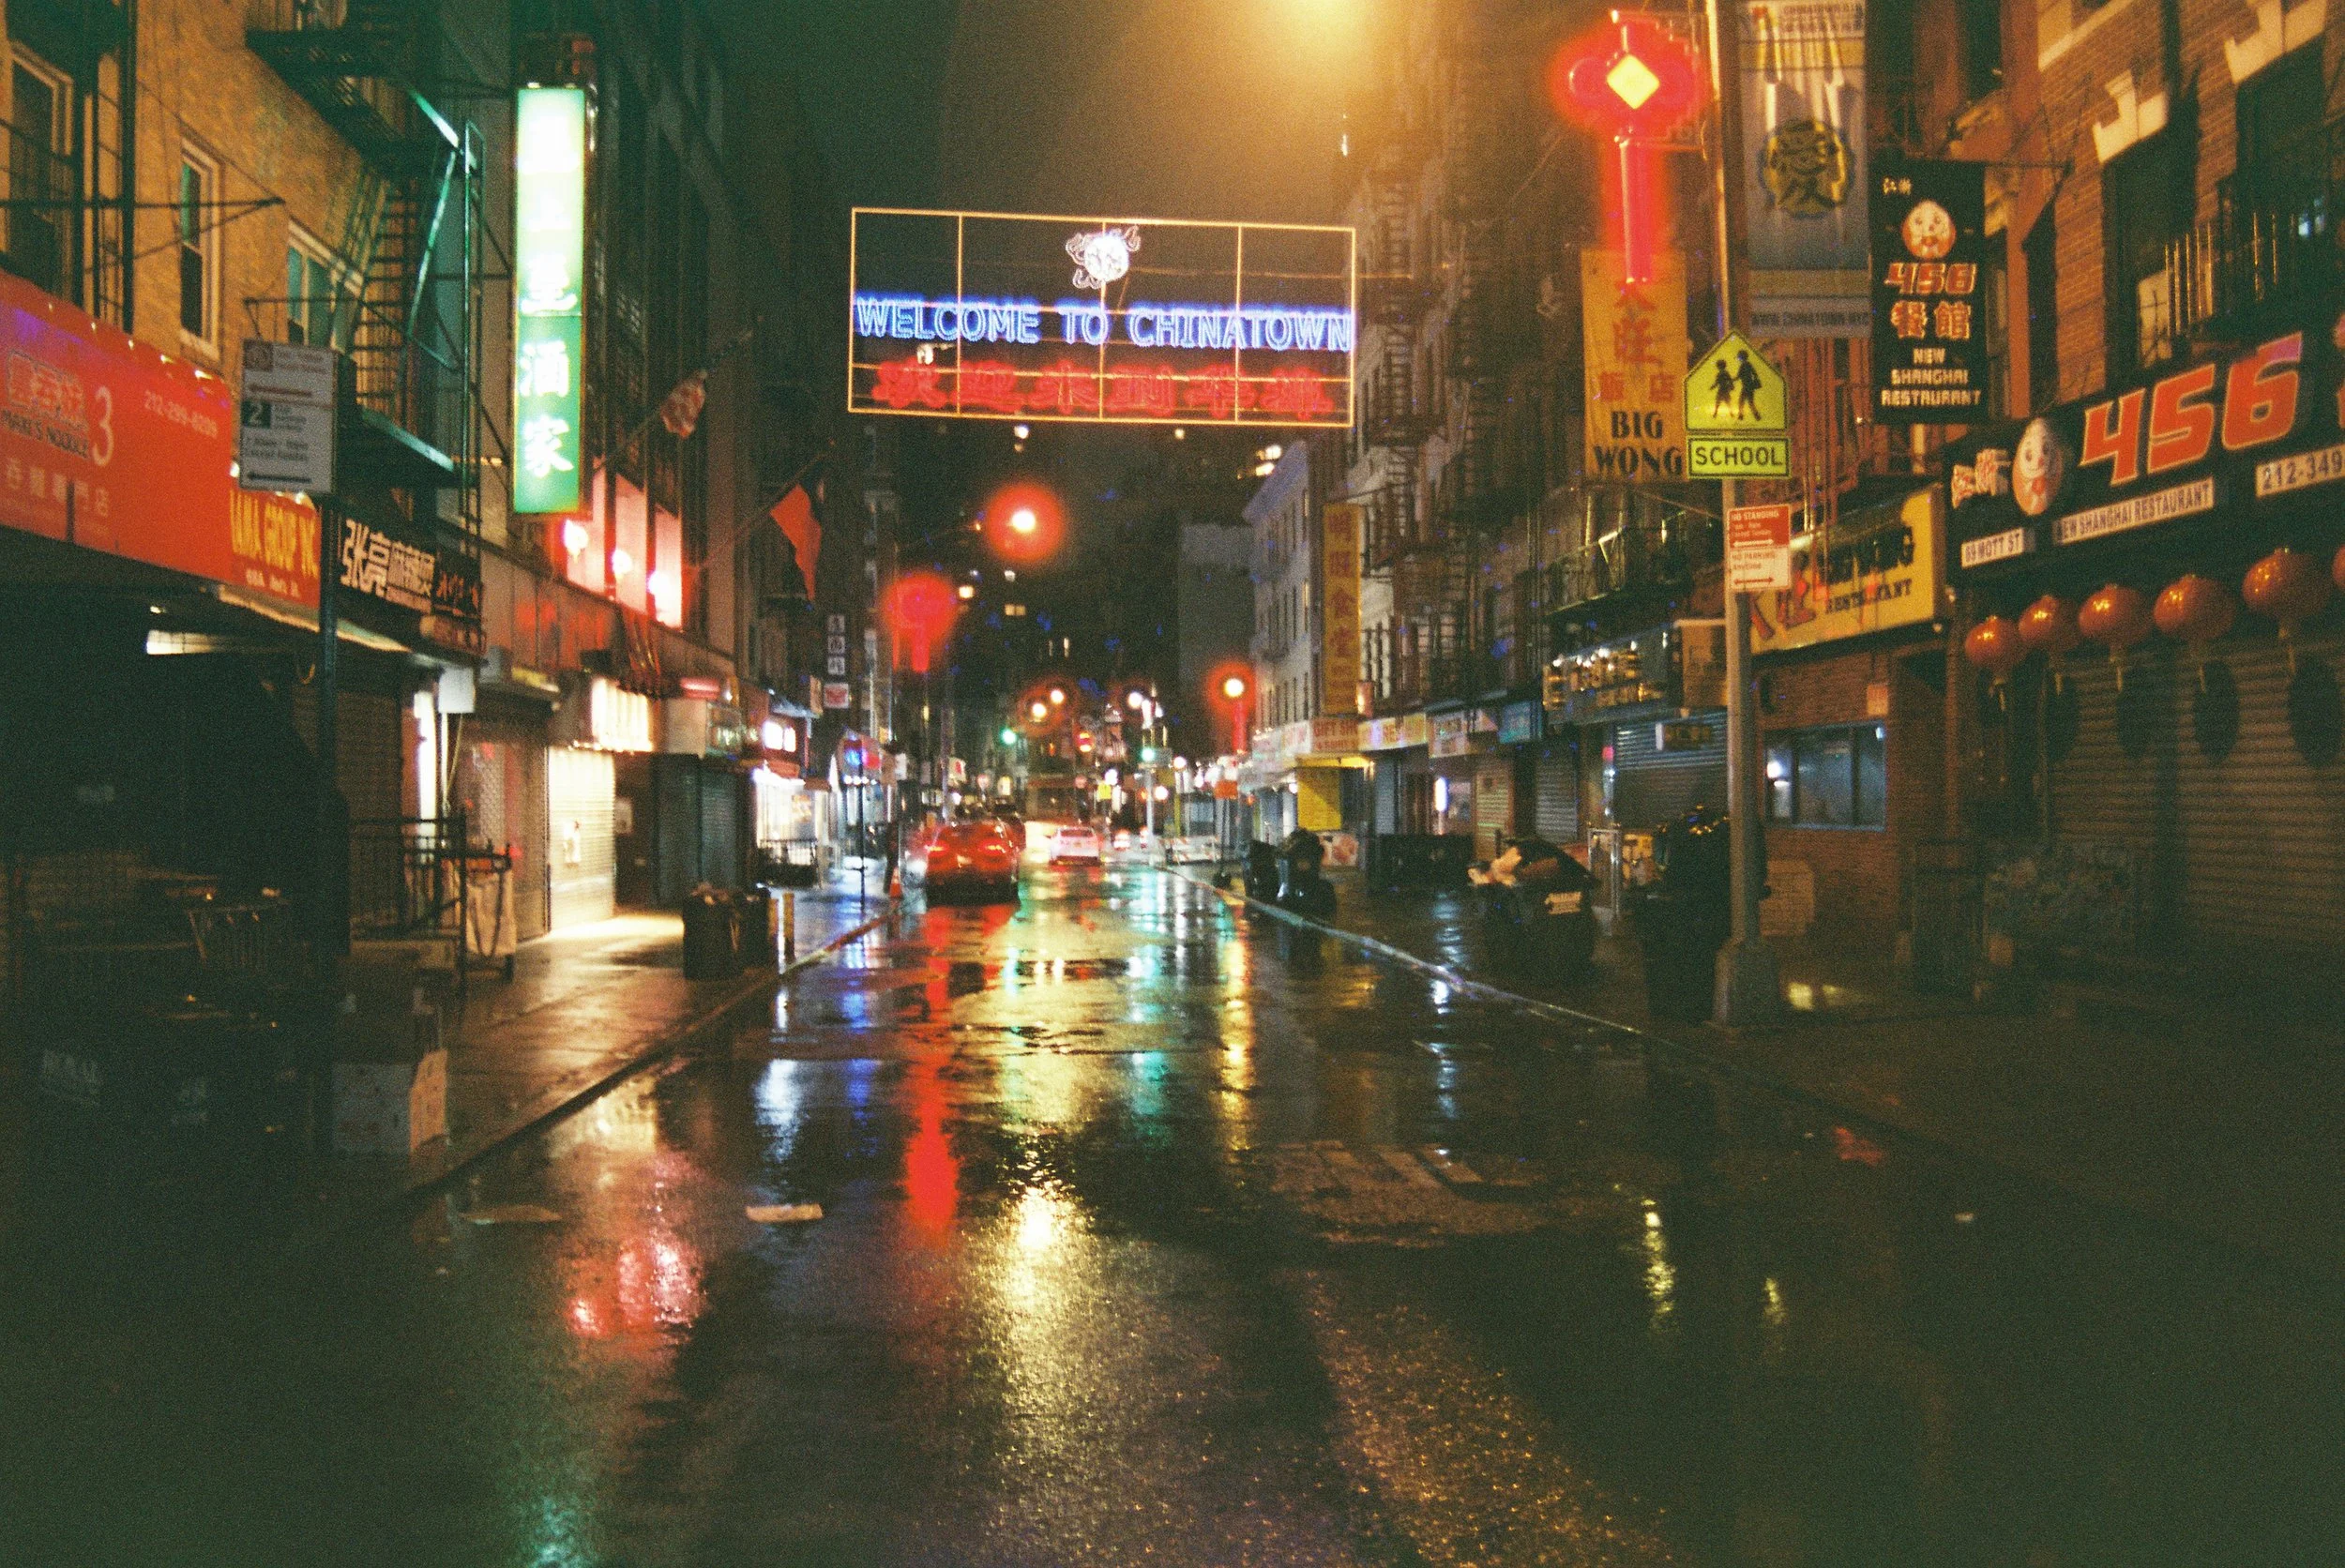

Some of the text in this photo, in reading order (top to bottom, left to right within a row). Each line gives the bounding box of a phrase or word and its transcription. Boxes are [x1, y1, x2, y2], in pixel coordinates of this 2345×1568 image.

[1884, 263, 1976, 295] 456
[855, 295, 1354, 352] WELCOME TO CHINATOWN
[1891, 301, 1971, 339] 餐館
[1913, 348, 1945, 365] NEW
[1891, 369, 1968, 385] SHANGHAI
[249, 400, 264, 425] 2
[1882, 389, 1981, 406] RESTAURANT
[2080, 331, 2302, 486] 456
[92, 385, 114, 467] 3
[1611, 410, 1663, 440] BIG
[1594, 445, 1683, 475] WONG
[1695, 445, 1783, 468] SCHOOL
[2079, 504, 2133, 535] SHANGHAI
[2134, 482, 2209, 521] RESTAURANT
